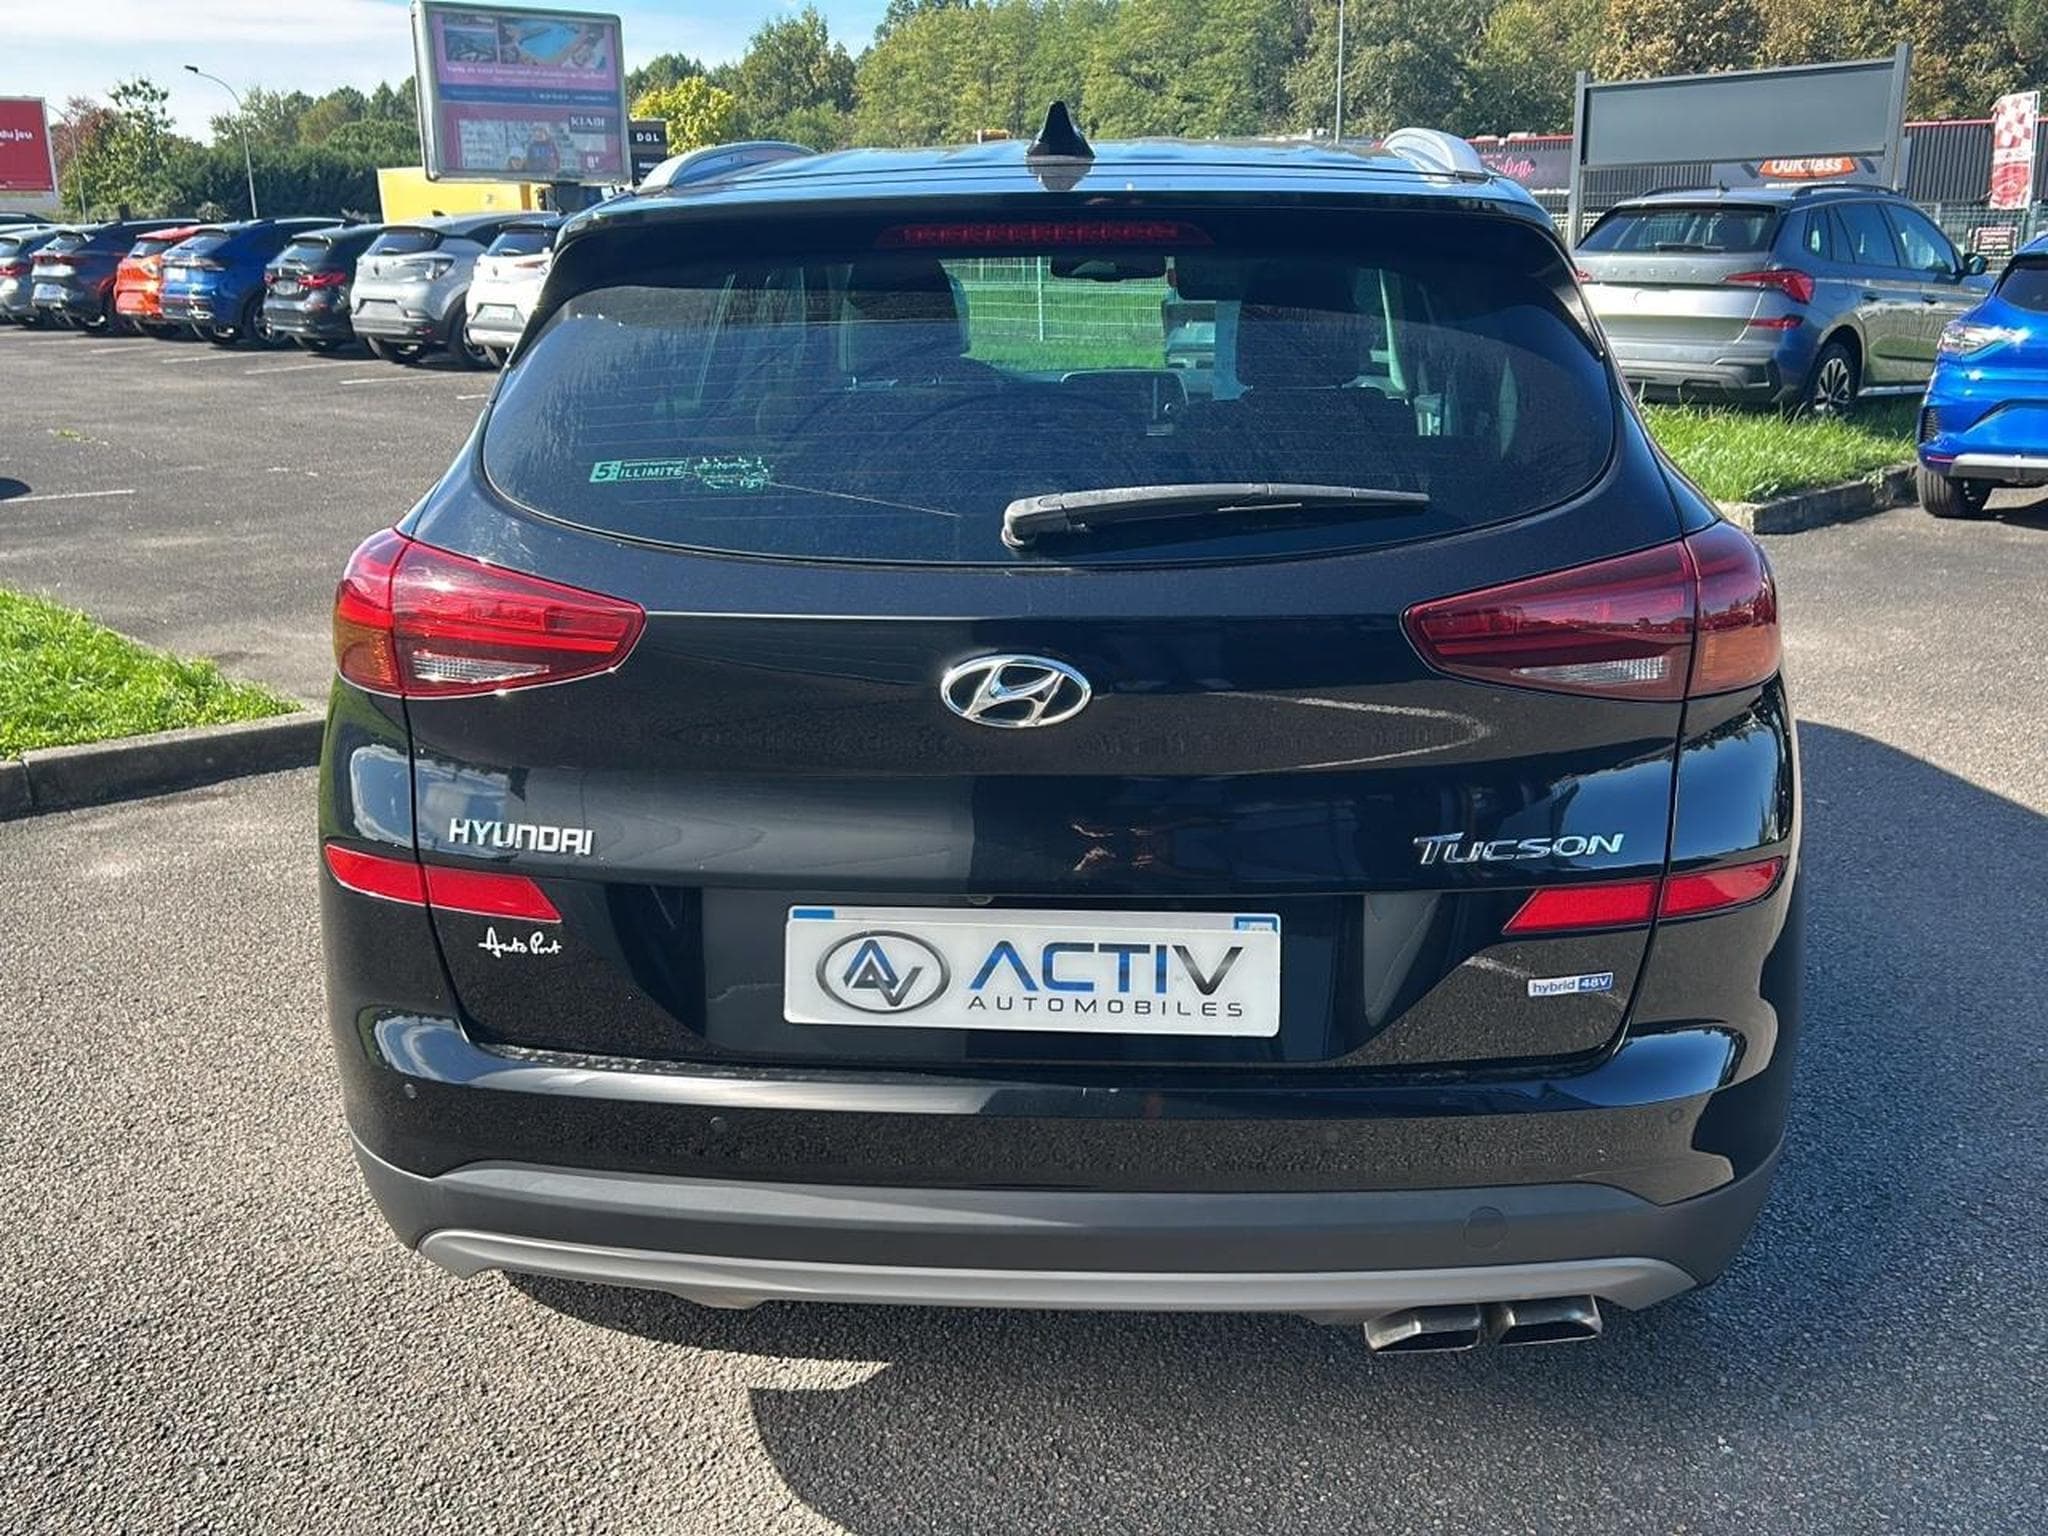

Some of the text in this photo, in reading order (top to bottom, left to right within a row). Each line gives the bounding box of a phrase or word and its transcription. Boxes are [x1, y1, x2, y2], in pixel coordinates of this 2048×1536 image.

[636, 131, 660, 142] DOL
[595, 463, 612, 479] 5
[448, 817, 595, 855] HYUNDAI
[1412, 831, 1625, 866] TUCSON
[478, 926, 528, 958] Auto
[968, 939, 1244, 996] ACTIV
[1532, 975, 1610, 994] hybrid 48V
[967, 995, 1243, 1018] AUTOMOBILES
